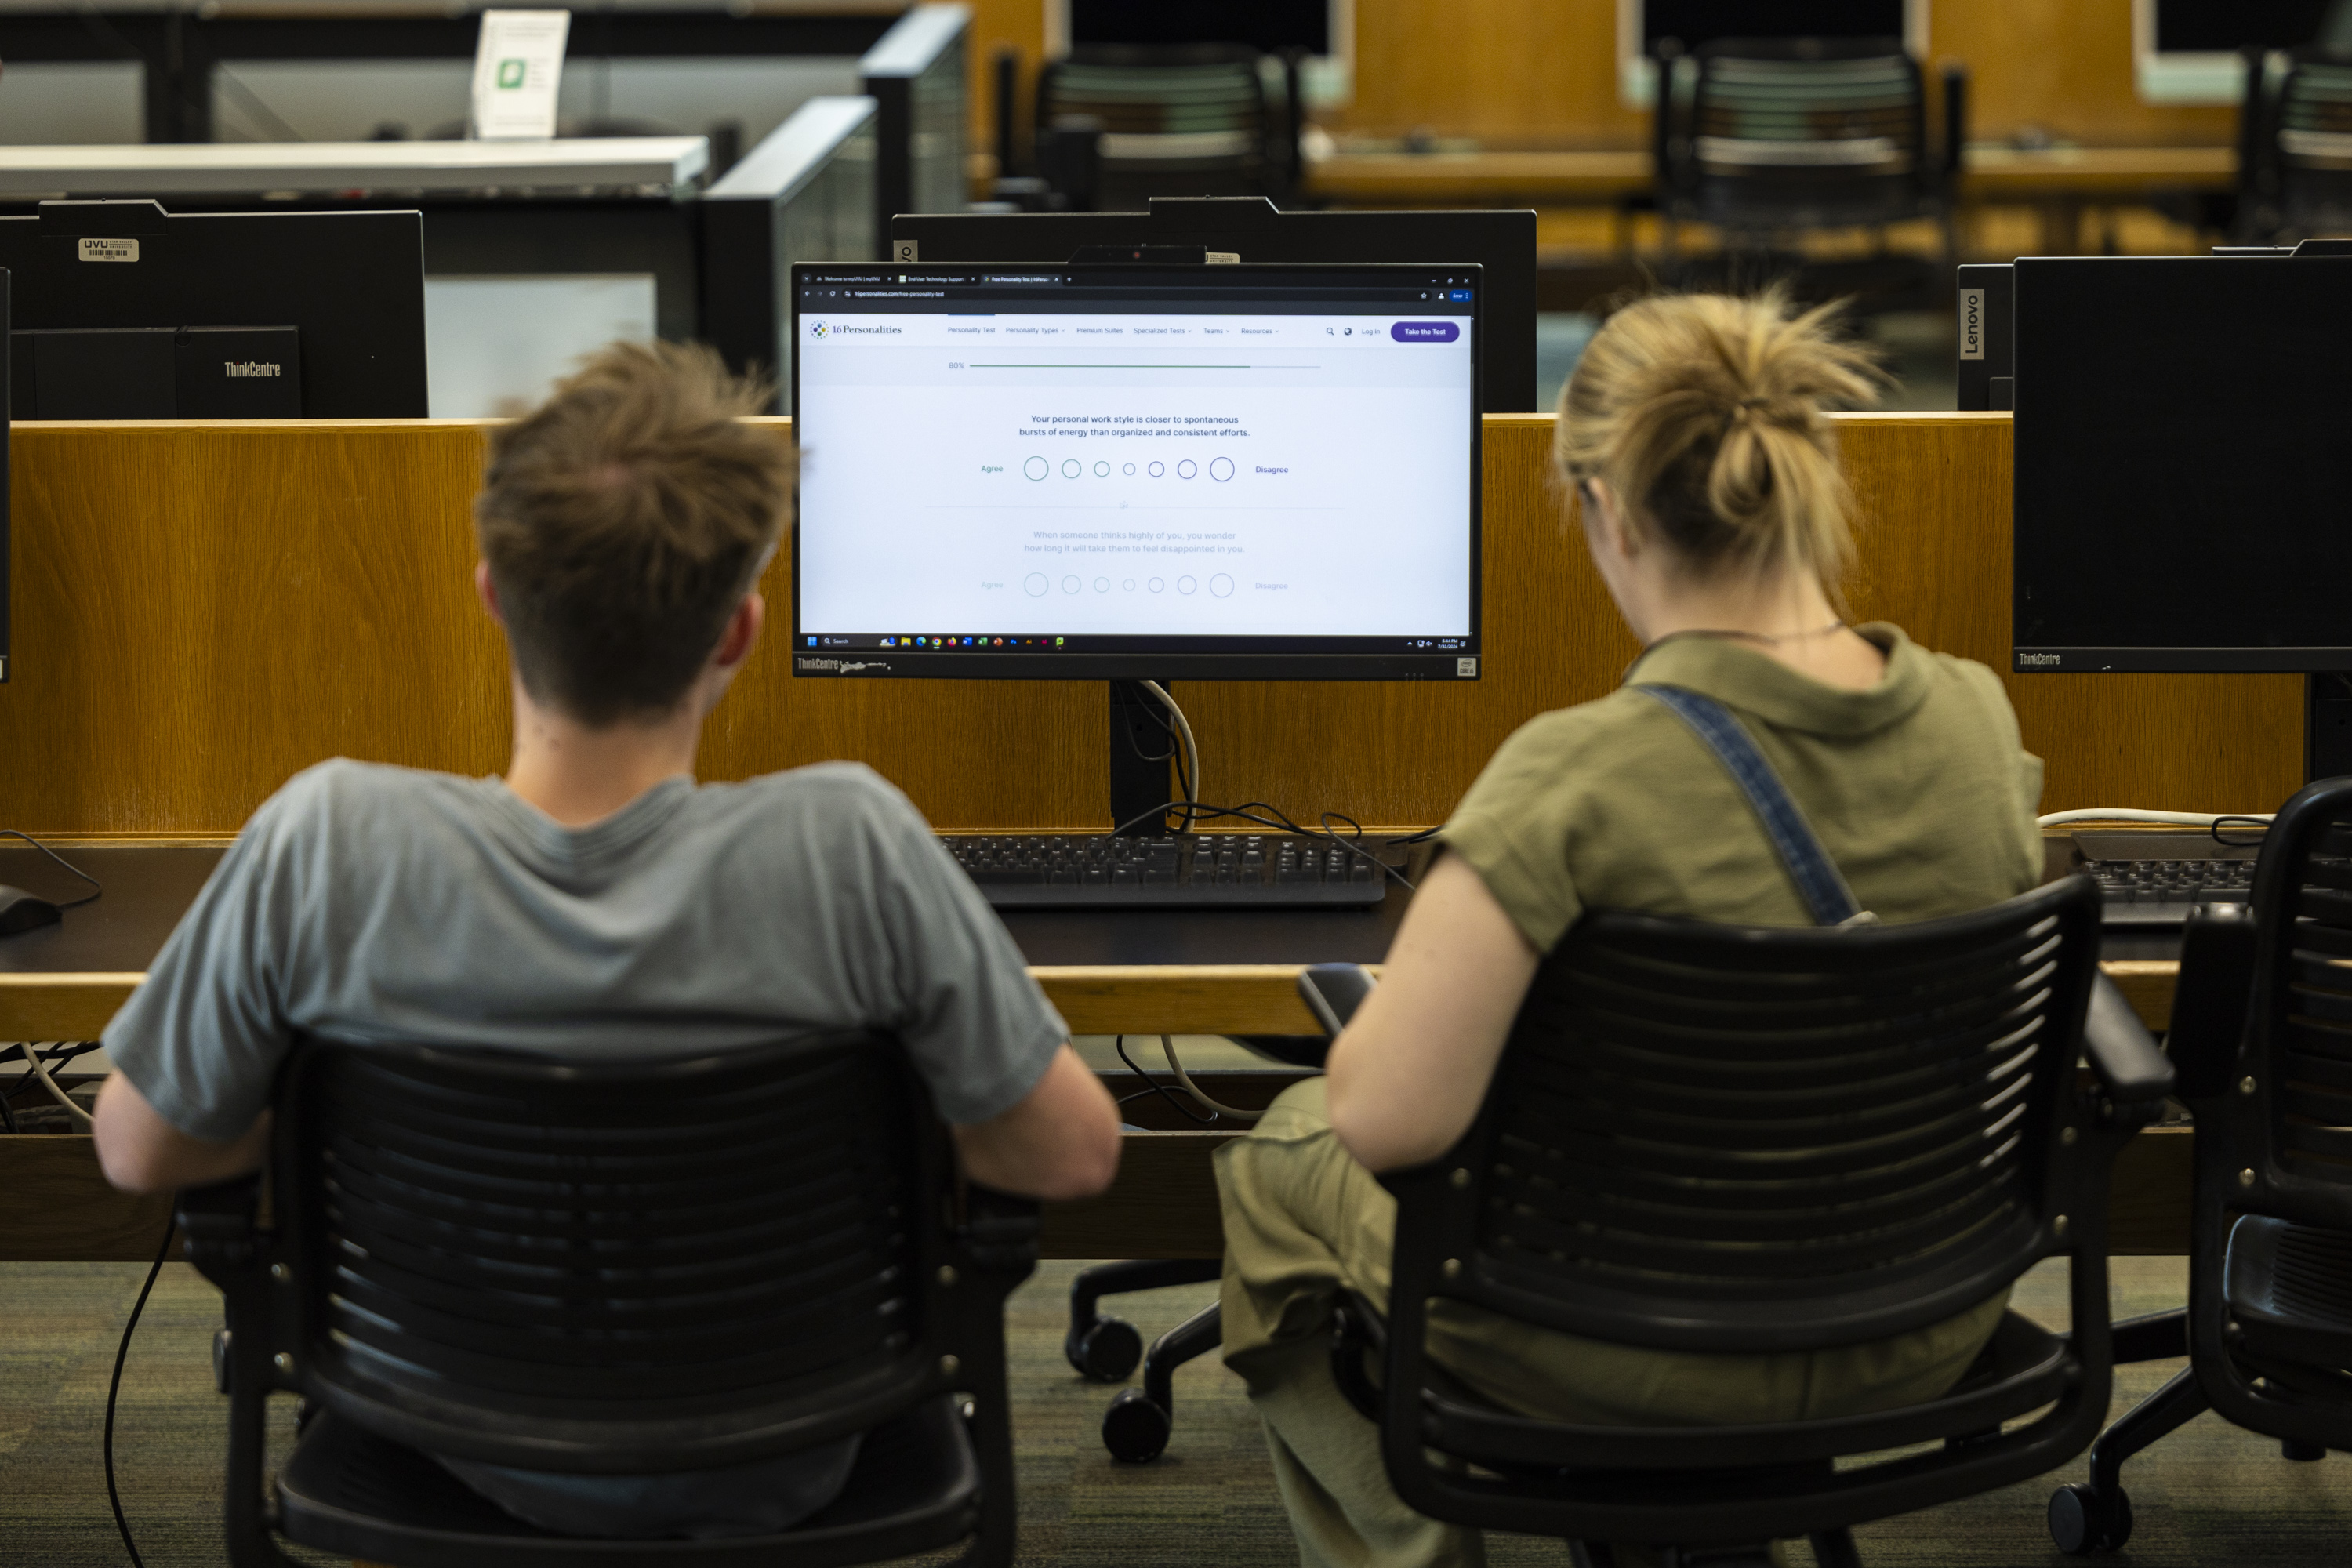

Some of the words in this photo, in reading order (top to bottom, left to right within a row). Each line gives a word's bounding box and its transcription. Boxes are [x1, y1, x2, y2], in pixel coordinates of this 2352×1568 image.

[85, 240, 108, 249] UVU
[1965, 295, 1978, 354] Lenovo
[224, 361, 281, 377] ThinkCentre
[1052, 416, 1089, 424] personal
[1113, 416, 1134, 424] style
[1184, 416, 1239, 425] spontaneous
[1111, 429, 1153, 437] organized
[981, 465, 1004, 474] Agree
[1255, 466, 1289, 474] Disagree
[1128, 532, 1154, 541] highly
[1167, 532, 1185, 541] you,
[1044, 544, 1063, 554] long
[1142, 544, 1159, 553] feel
[1160, 544, 1216, 554] disappointed
[981, 581, 1004, 590] Agree
[1255, 583, 1289, 591] Disagree
[2019, 653, 2060, 665] ThinkCentre
[797, 658, 839, 670] ThinkCentre
